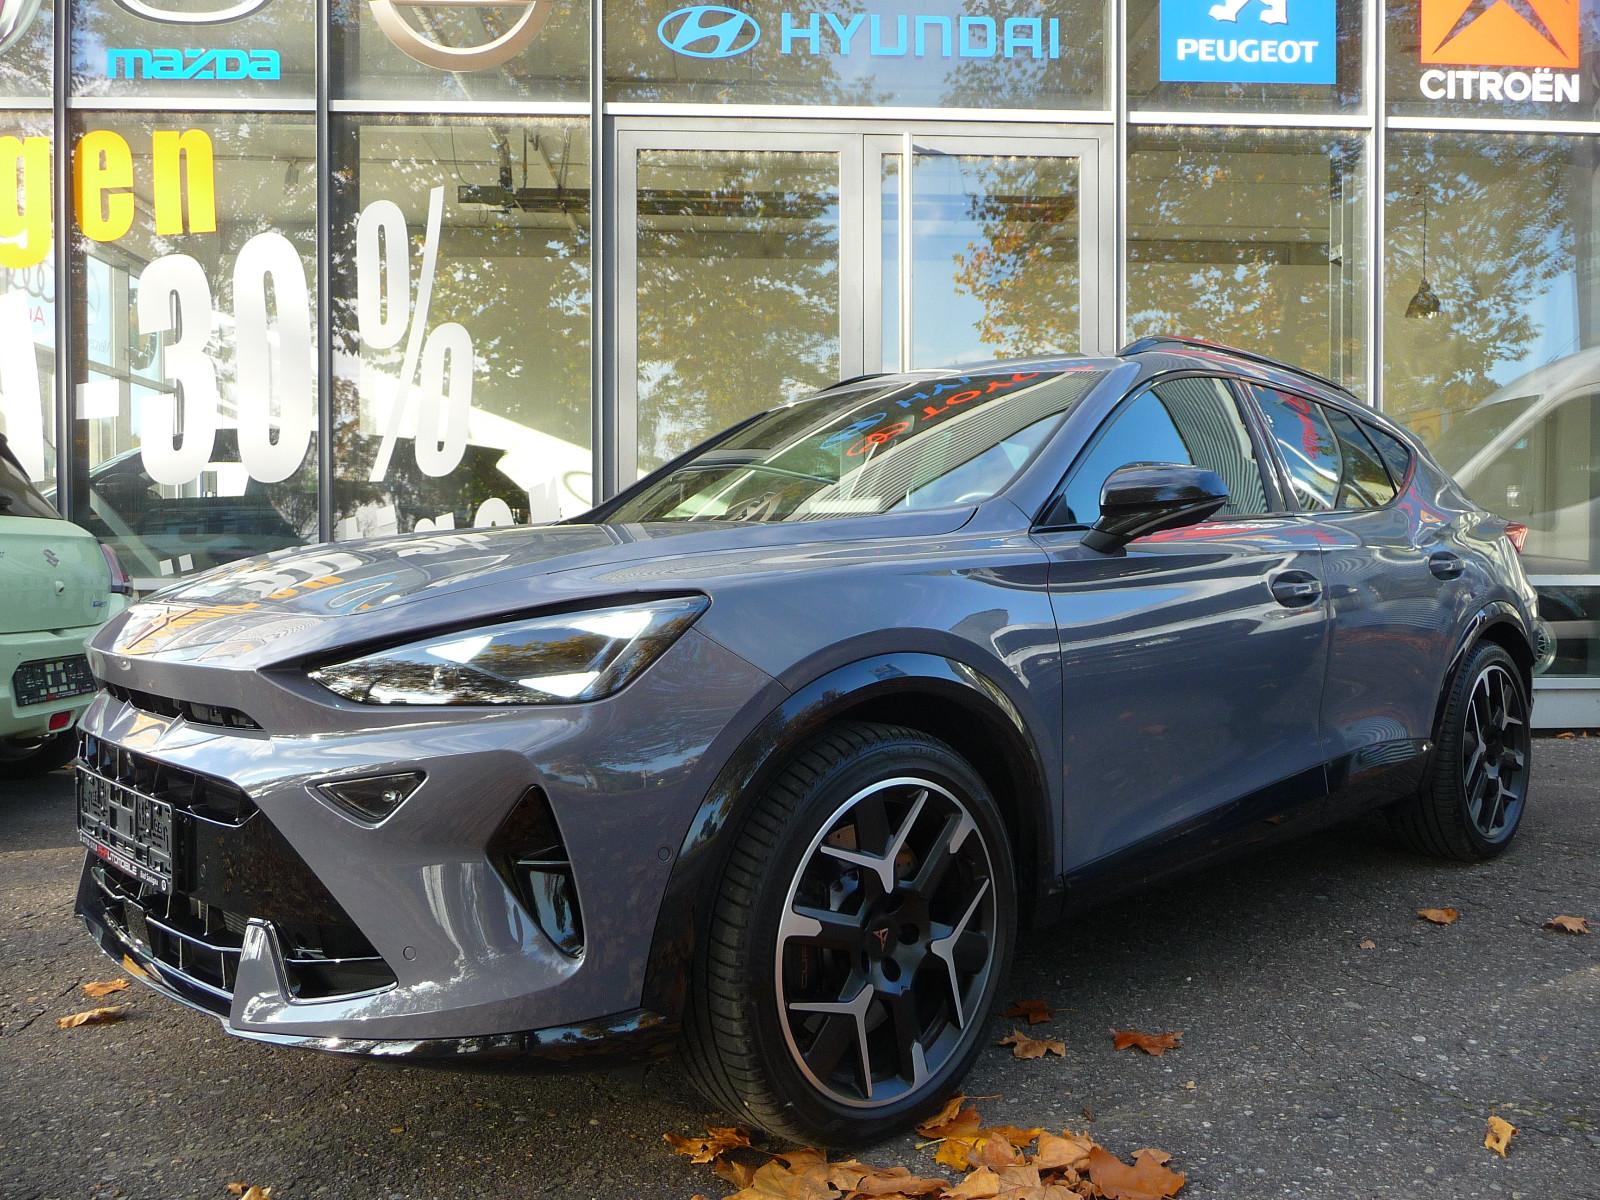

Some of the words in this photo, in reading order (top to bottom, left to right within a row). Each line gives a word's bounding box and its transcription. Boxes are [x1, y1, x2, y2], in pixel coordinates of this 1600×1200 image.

[781, 12, 1059, 59] HYUNDAI
[1177, 38, 1318, 63] PEUGEOT
[1419, 67, 1579, 103] CITROËN
